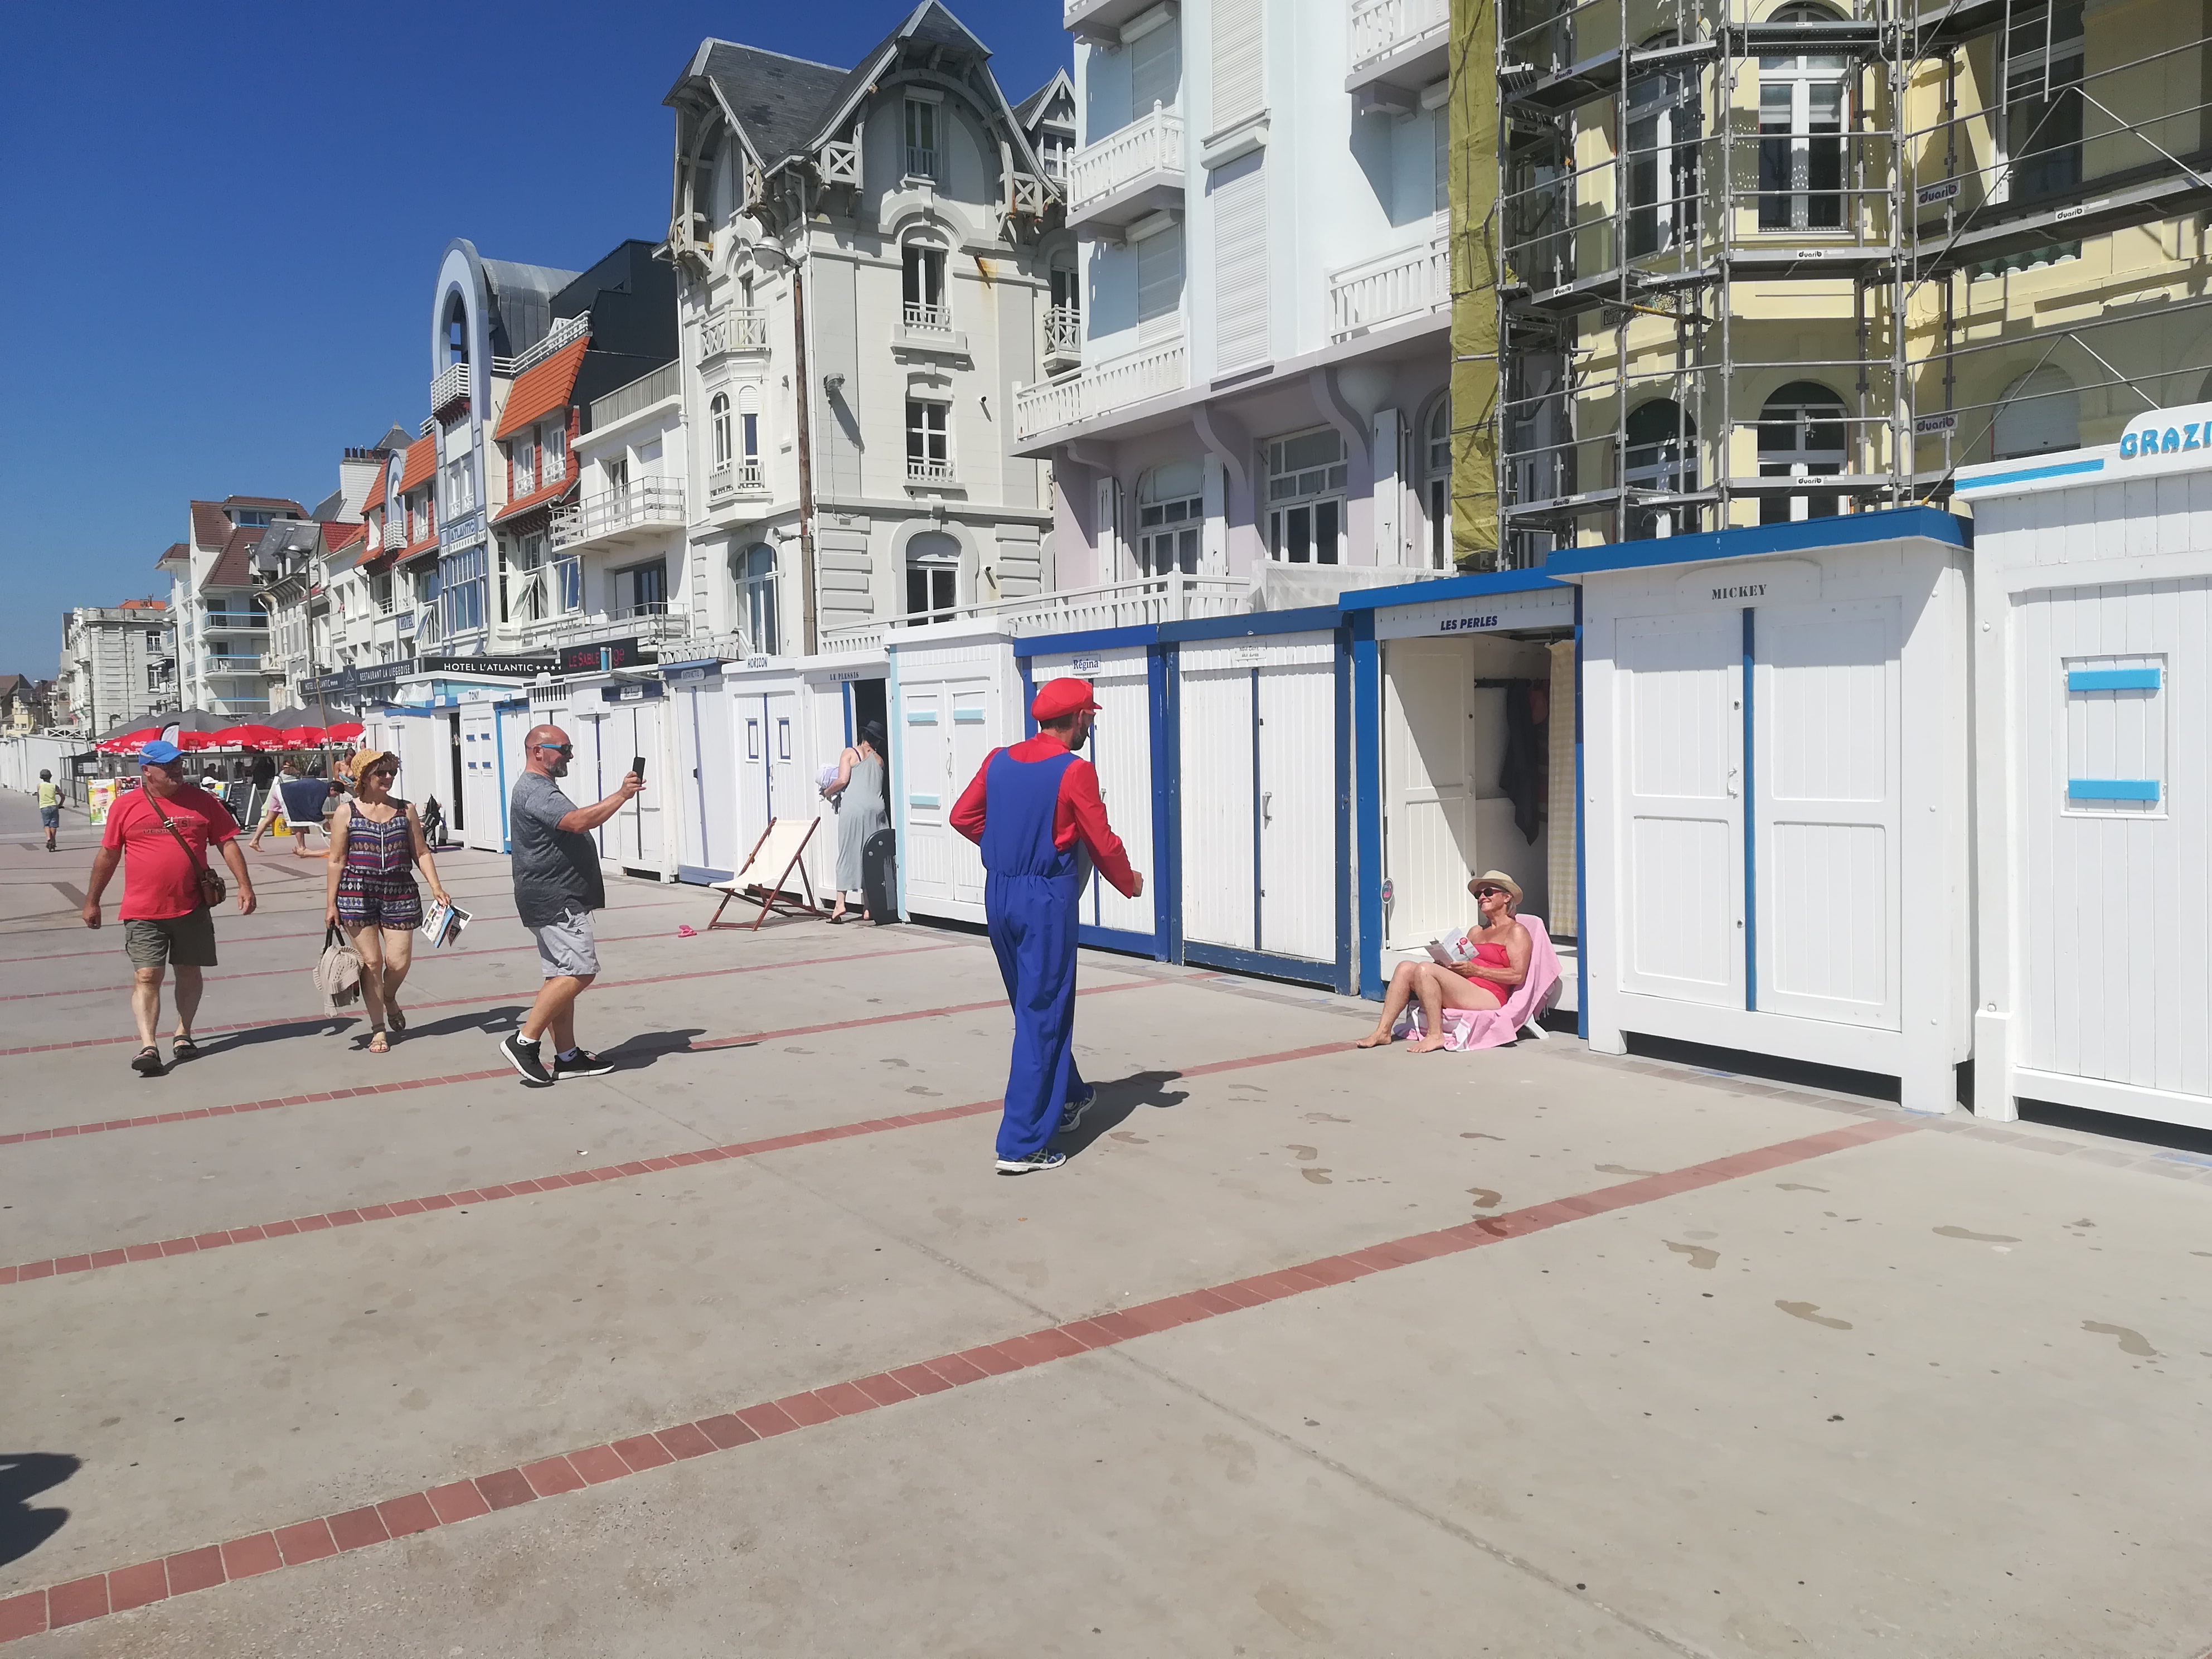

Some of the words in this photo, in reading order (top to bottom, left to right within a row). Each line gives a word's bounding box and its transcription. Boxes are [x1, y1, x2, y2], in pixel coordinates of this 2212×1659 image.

[1919, 184, 1957, 203] duarib
[2058, 208, 2083, 219] duarib
[1555, 285, 1571, 295] duarib
[1917, 416, 1954, 431] duarib
[451, 519, 475, 541] ATLANTIC
[1712, 584, 1767, 600] MICKEY
[400, 615, 414, 628] HOTEL
[1440, 619, 1457, 630] LES
[1460, 615, 1497, 629] PERLES
[578, 651, 600, 667] SABLE
[748, 657, 768, 668] HORIZON
[1073, 658, 1098, 671] Régina
[360, 669, 381, 681] RESTAURANT
[383, 668, 387, 678] LA
[389, 664, 410, 677] LIEGEOISE
[444, 663, 476, 671] HOTEL
[480, 663, 533, 672] L'ATLANTIC
[838, 671, 859, 680] PLESSIS
[469, 691, 479, 700] TONY
